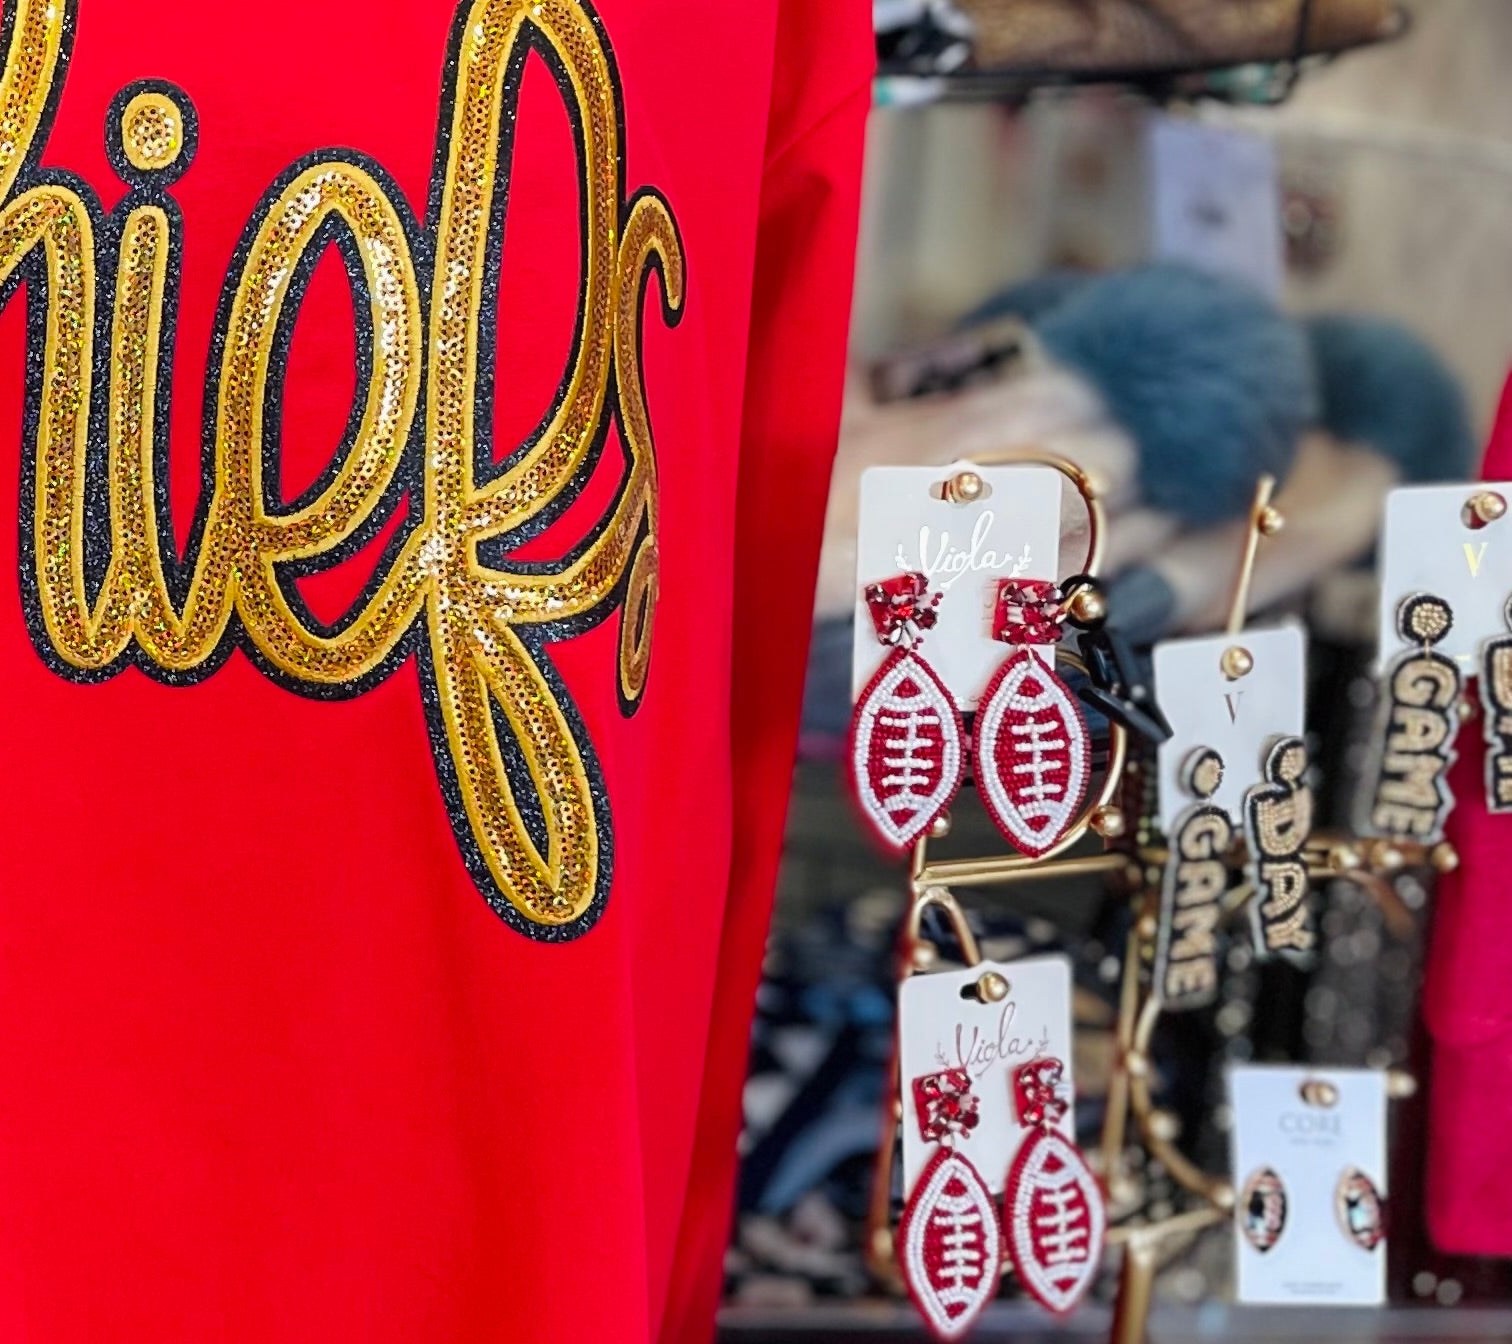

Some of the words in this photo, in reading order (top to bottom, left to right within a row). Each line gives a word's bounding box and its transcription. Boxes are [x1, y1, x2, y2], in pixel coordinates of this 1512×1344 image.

[919, 510, 1012, 590] Viola
[1371, 655, 1460, 835] GAME
[1164, 810, 1232, 999] GAME
[1252, 784, 1317, 952] DAY
[955, 1001, 1033, 1078] Viola
